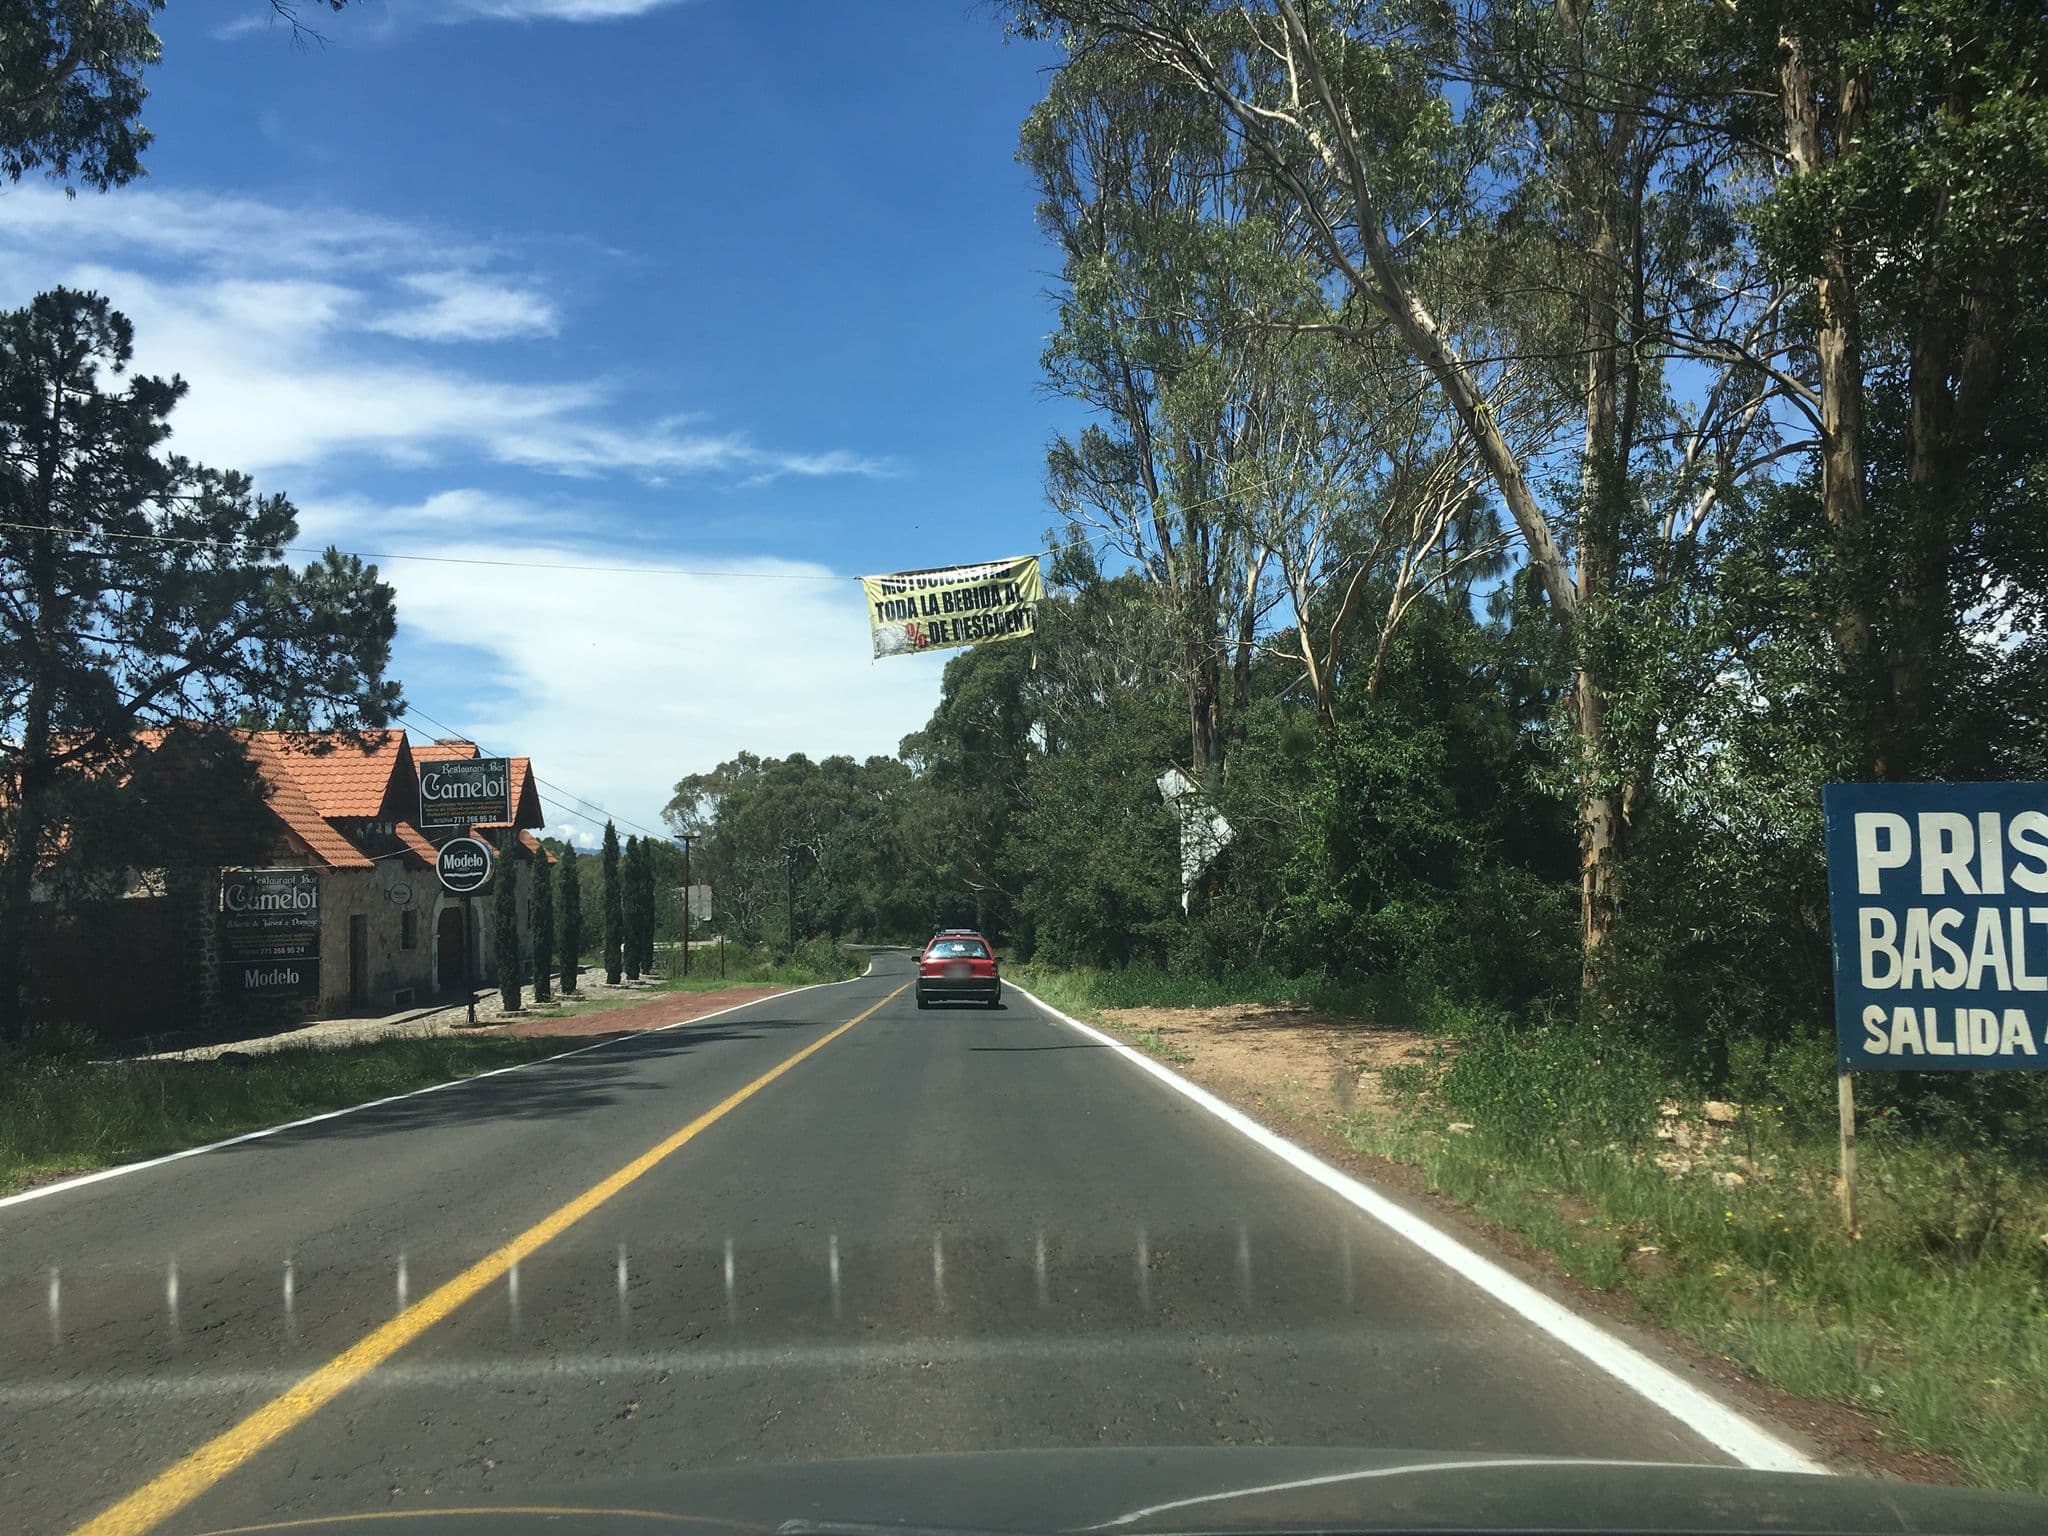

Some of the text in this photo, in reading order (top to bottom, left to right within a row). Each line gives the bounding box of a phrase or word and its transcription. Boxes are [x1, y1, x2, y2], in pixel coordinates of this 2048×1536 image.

[875, 582, 1024, 623] TODA LA BEBIDA AL
[928, 619, 950, 644] DE
[441, 762, 505, 777] Restaurant Bar
[422, 773, 506, 800] Camelot
[443, 853, 483, 869] Modelo
[225, 884, 319, 911] Camelot
[245, 968, 300, 988] Modelo
[1862, 1004, 2038, 1056] SALIDA
